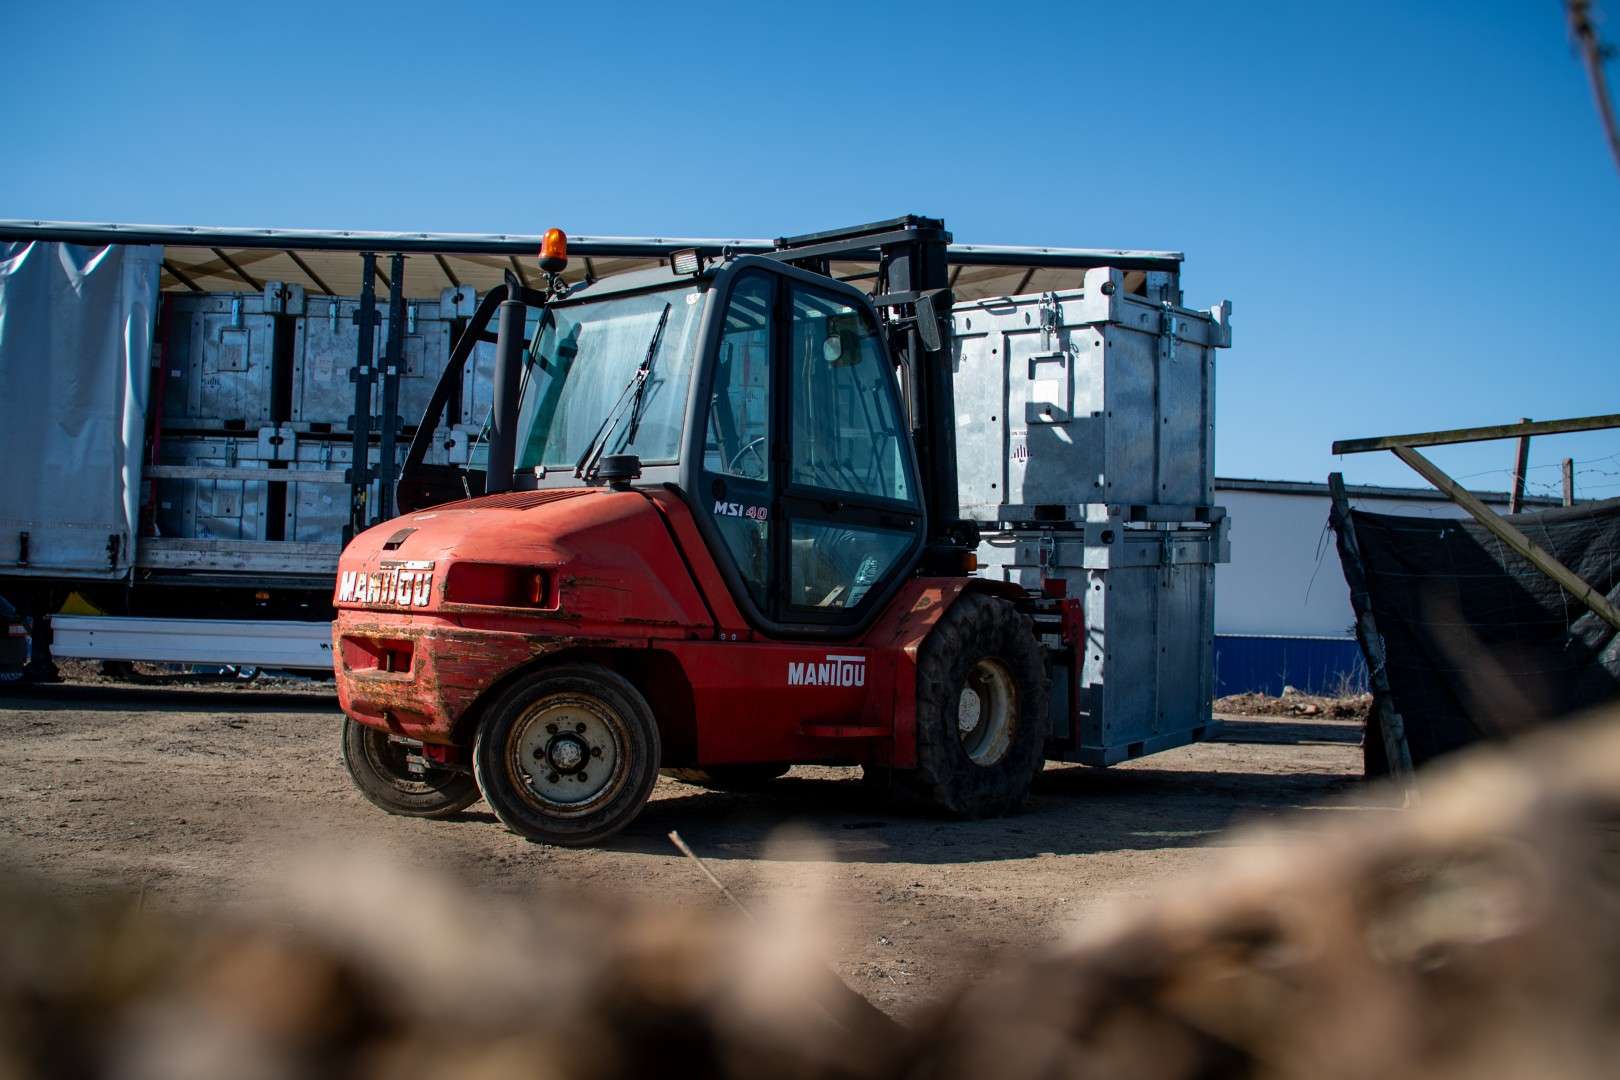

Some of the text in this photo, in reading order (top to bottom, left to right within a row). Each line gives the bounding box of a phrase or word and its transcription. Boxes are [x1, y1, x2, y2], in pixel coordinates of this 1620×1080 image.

[746, 505, 768, 520] 40
[340, 560, 435, 606] MANITOU
[787, 655, 866, 687] MANITOU
